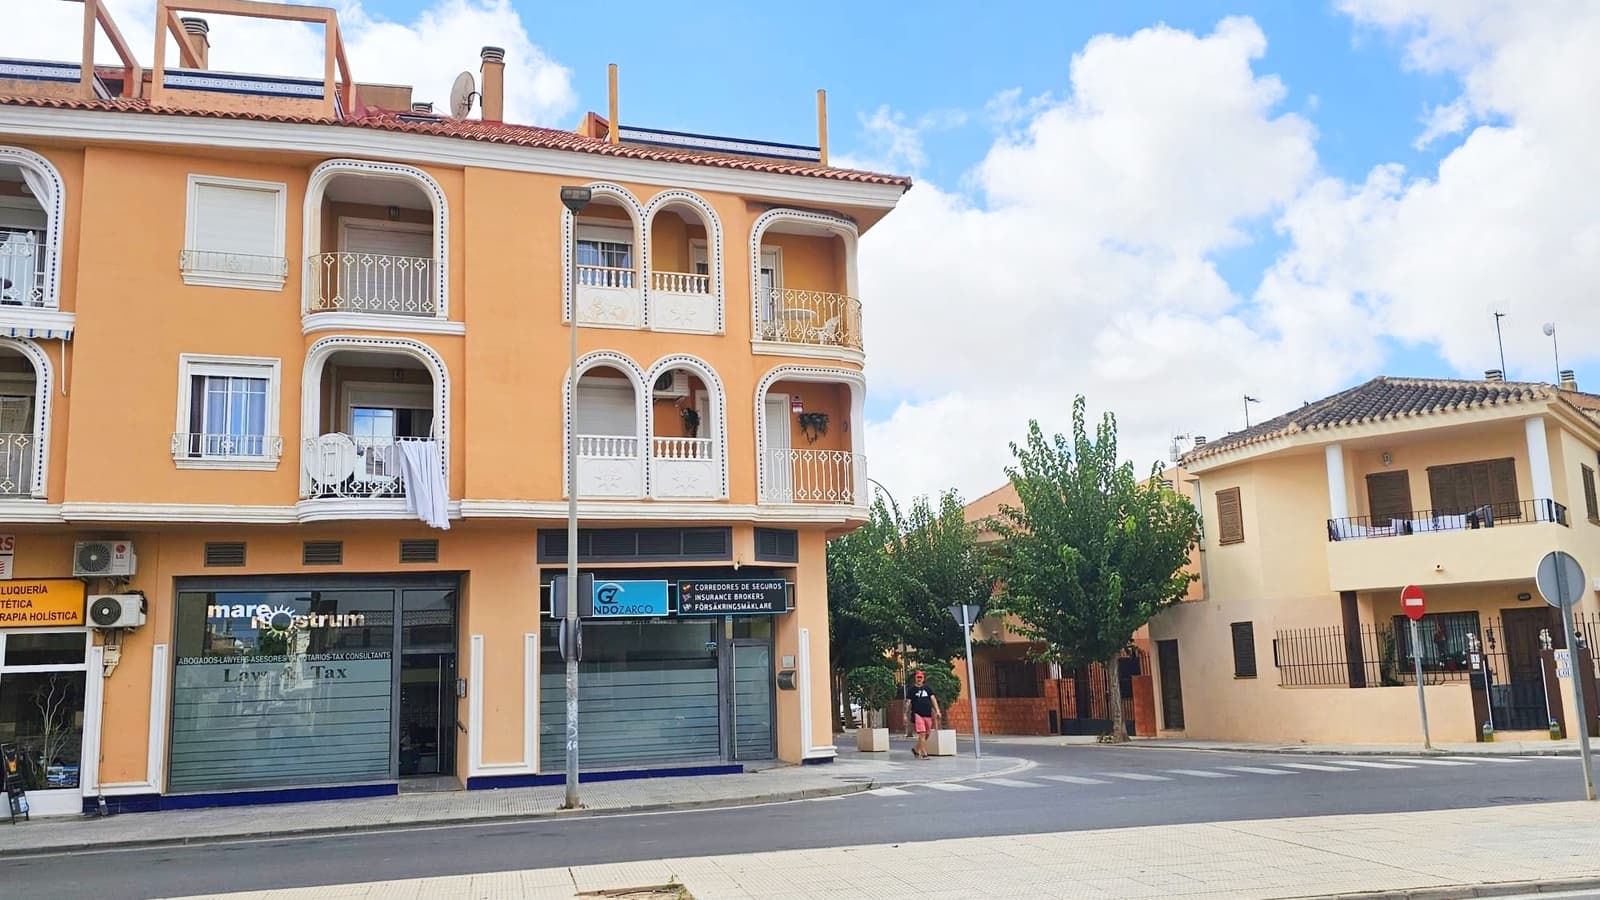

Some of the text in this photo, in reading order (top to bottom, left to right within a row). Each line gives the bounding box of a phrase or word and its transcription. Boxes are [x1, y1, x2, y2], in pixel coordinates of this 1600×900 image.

[694, 583, 739, 591] CORREDORES
[752, 582, 782, 590] SEGUROS
[694, 593, 732, 601] INSURANCE
[30, 610, 78, 621] HOLÍSTICA
[207, 604, 272, 618] mare
[310, 665, 347, 679] Tax
